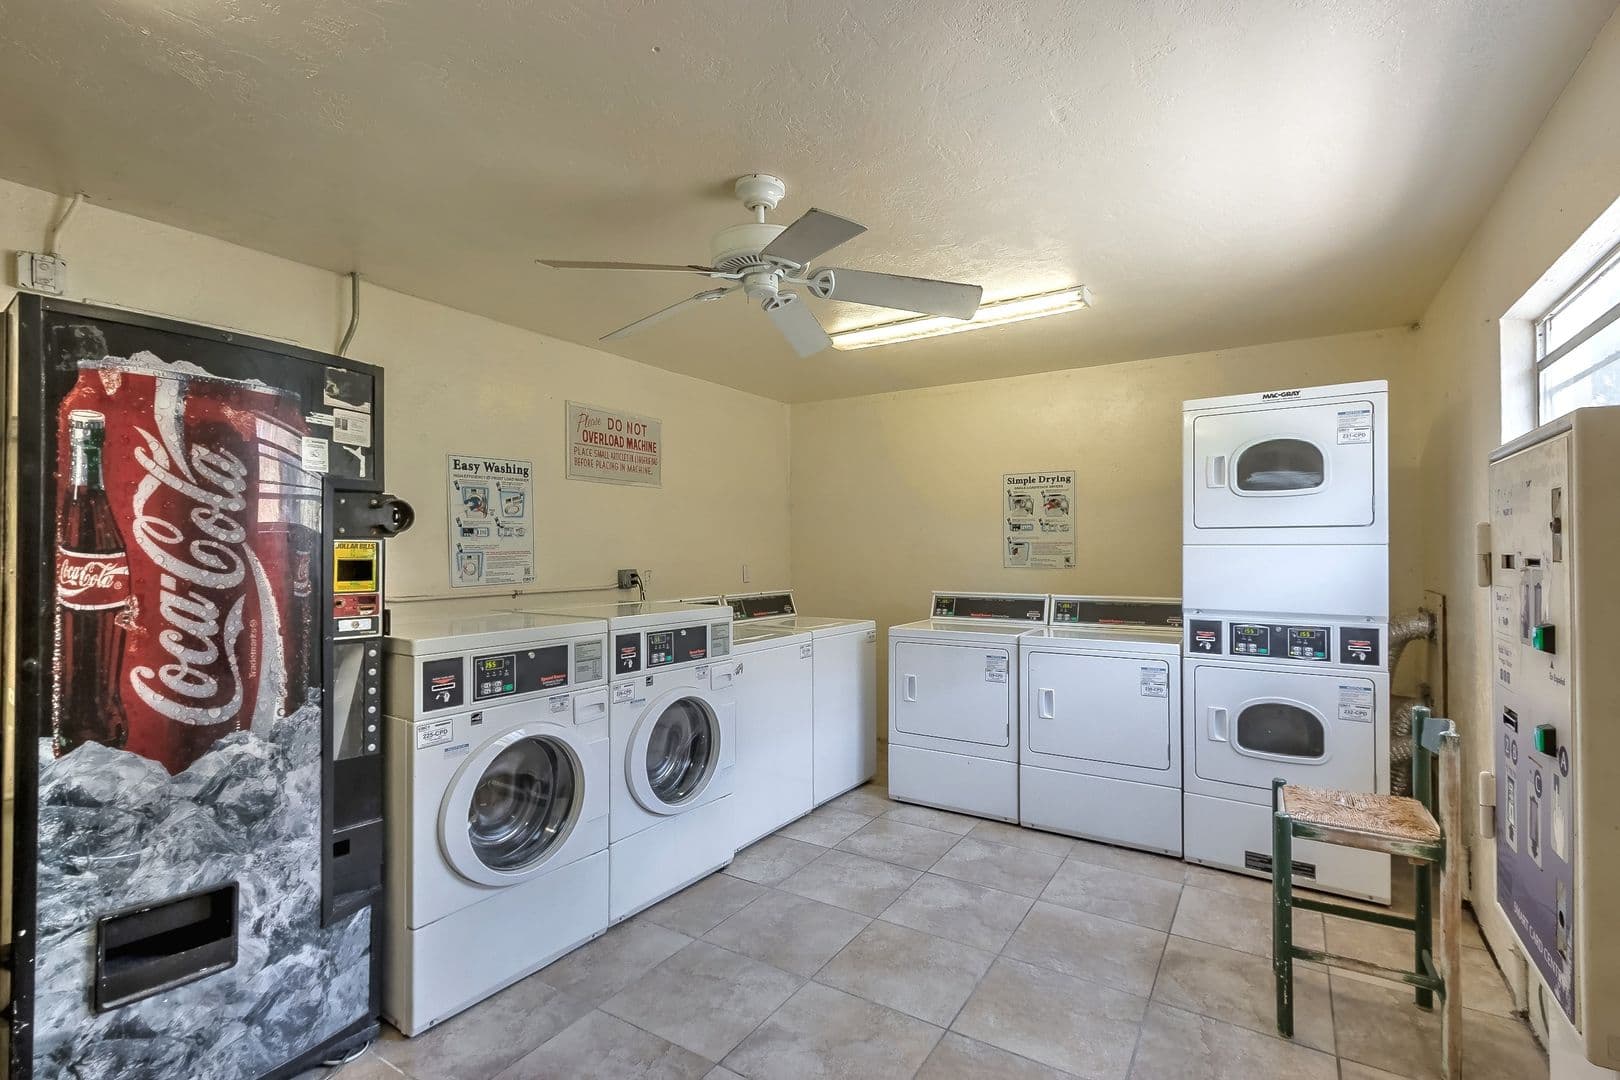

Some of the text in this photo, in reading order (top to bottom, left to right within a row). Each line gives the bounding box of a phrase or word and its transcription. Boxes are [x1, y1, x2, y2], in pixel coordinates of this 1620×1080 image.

[607, 417, 623, 432] DO
[626, 421, 648, 437] NOT
[582, 429, 657, 454] OVERLOAD MACHINE
[573, 446, 593, 458] PLACE
[594, 450, 610, 460] SMALL
[453, 459, 530, 478] Easy Washing
[573, 457, 594, 468] BEFORE
[595, 460, 619, 471] PLACING
[1006, 475, 1072, 486] Simple Drying
